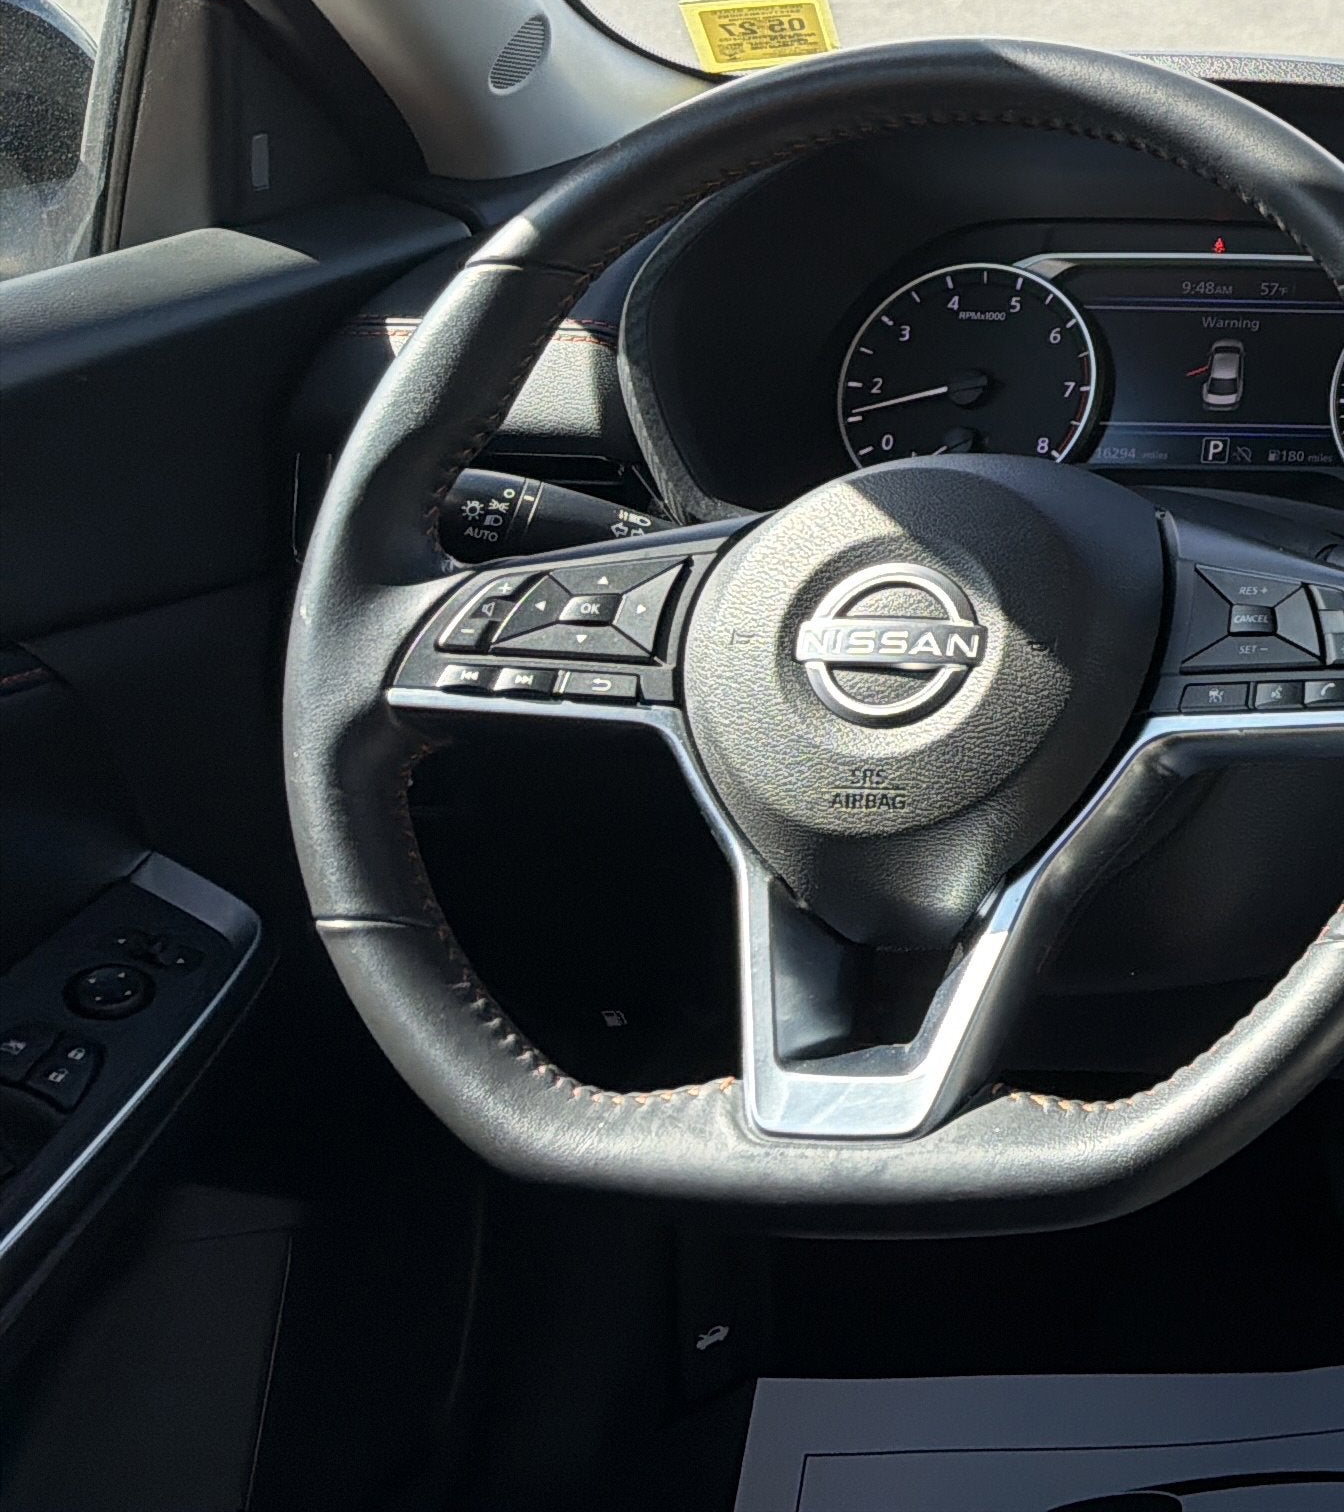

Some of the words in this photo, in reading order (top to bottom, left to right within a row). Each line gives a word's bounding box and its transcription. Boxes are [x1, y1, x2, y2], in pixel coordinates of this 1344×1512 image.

[947, 295, 960, 310] 4
[1009, 296, 1022, 312] 5
[1201, 316, 1260, 331] Warning
[899, 325, 911, 341] 3
[1049, 328, 1061, 344] 6
[870, 377, 883, 394] 2
[1063, 381, 1076, 397] 7
[881, 434, 894, 450] 0
[1036, 438, 1049, 454] 8
[1208, 440, 1225, 461] P
[1280, 450, 1305, 463] 180
[464, 525, 499, 543] AUTO
[1239, 585, 1259, 595] RES
[580, 601, 600, 615] OK
[1233, 614, 1270, 624] CANCEL
[800, 629, 980, 659] NISSAN
[1239, 644, 1257, 655] SET
[850, 768, 887, 785] SRS
[830, 793, 907, 811] AIRBAG
